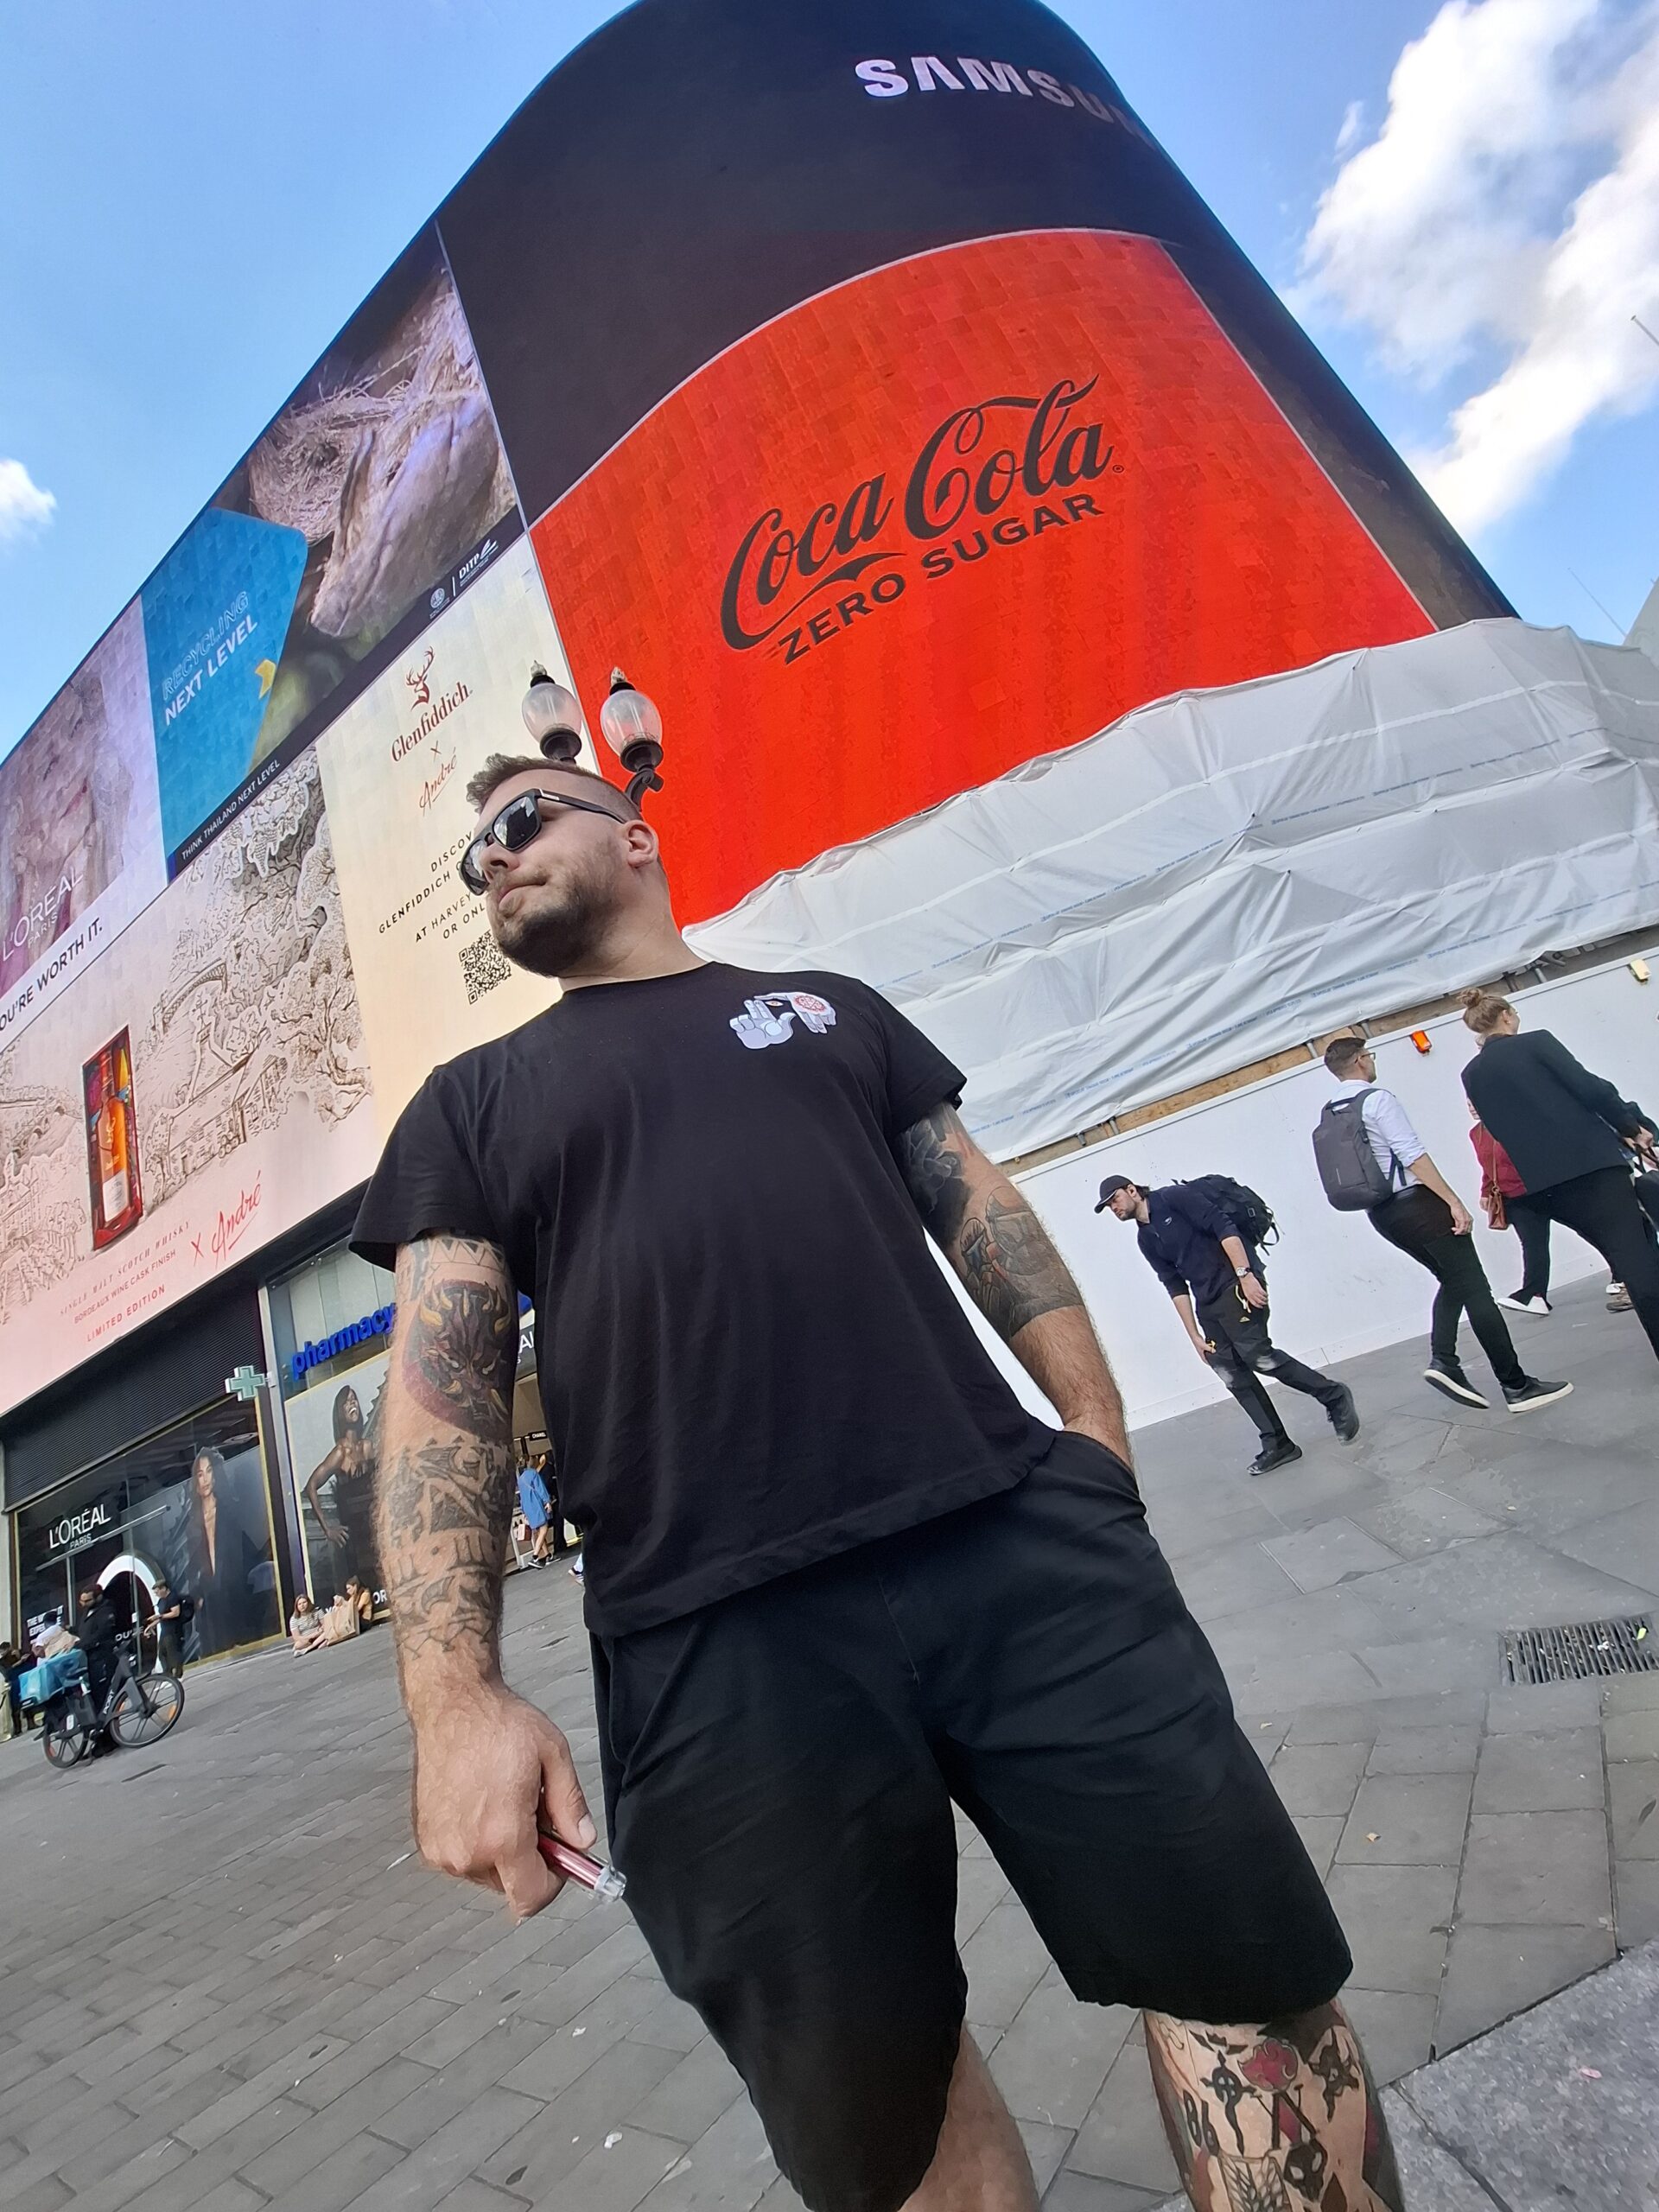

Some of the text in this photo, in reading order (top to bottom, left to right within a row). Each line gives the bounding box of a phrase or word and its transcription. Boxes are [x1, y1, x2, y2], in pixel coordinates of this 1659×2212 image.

[459, 552, 480, 580] DITP
[776, 493, 1105, 665] ZERO SUGAR
[162, 590, 249, 702] RECYCLING
[164, 614, 258, 727] NEXT LEVEL
[391, 681, 470, 762] Glenfiddich
[181, 759, 281, 861] THINK THAILAND NEXT LEVEL
[419, 746, 457, 817] André
[430, 831, 473, 873] DISCOV
[2, 866, 84, 963] L'ORÉAL
[27, 912, 59, 949] PARIS
[378, 870, 451, 934] GLENFIDDICH
[415, 925, 429, 943] AT
[442, 902, 486, 939] OR ONL
[0, 917, 103, 1032] OU'RE WORTH IT.
[211, 1169, 262, 1270] André
[73, 1249, 176, 1325] BORDEAUX WINE CASK FINISH
[86, 1283, 166, 1342] LIMITED EDITION
[291, 1302, 397, 1381] pharmacy
[48, 1503, 111, 1549] L'ORÉAL
[69, 1532, 92, 1549] PARIS
